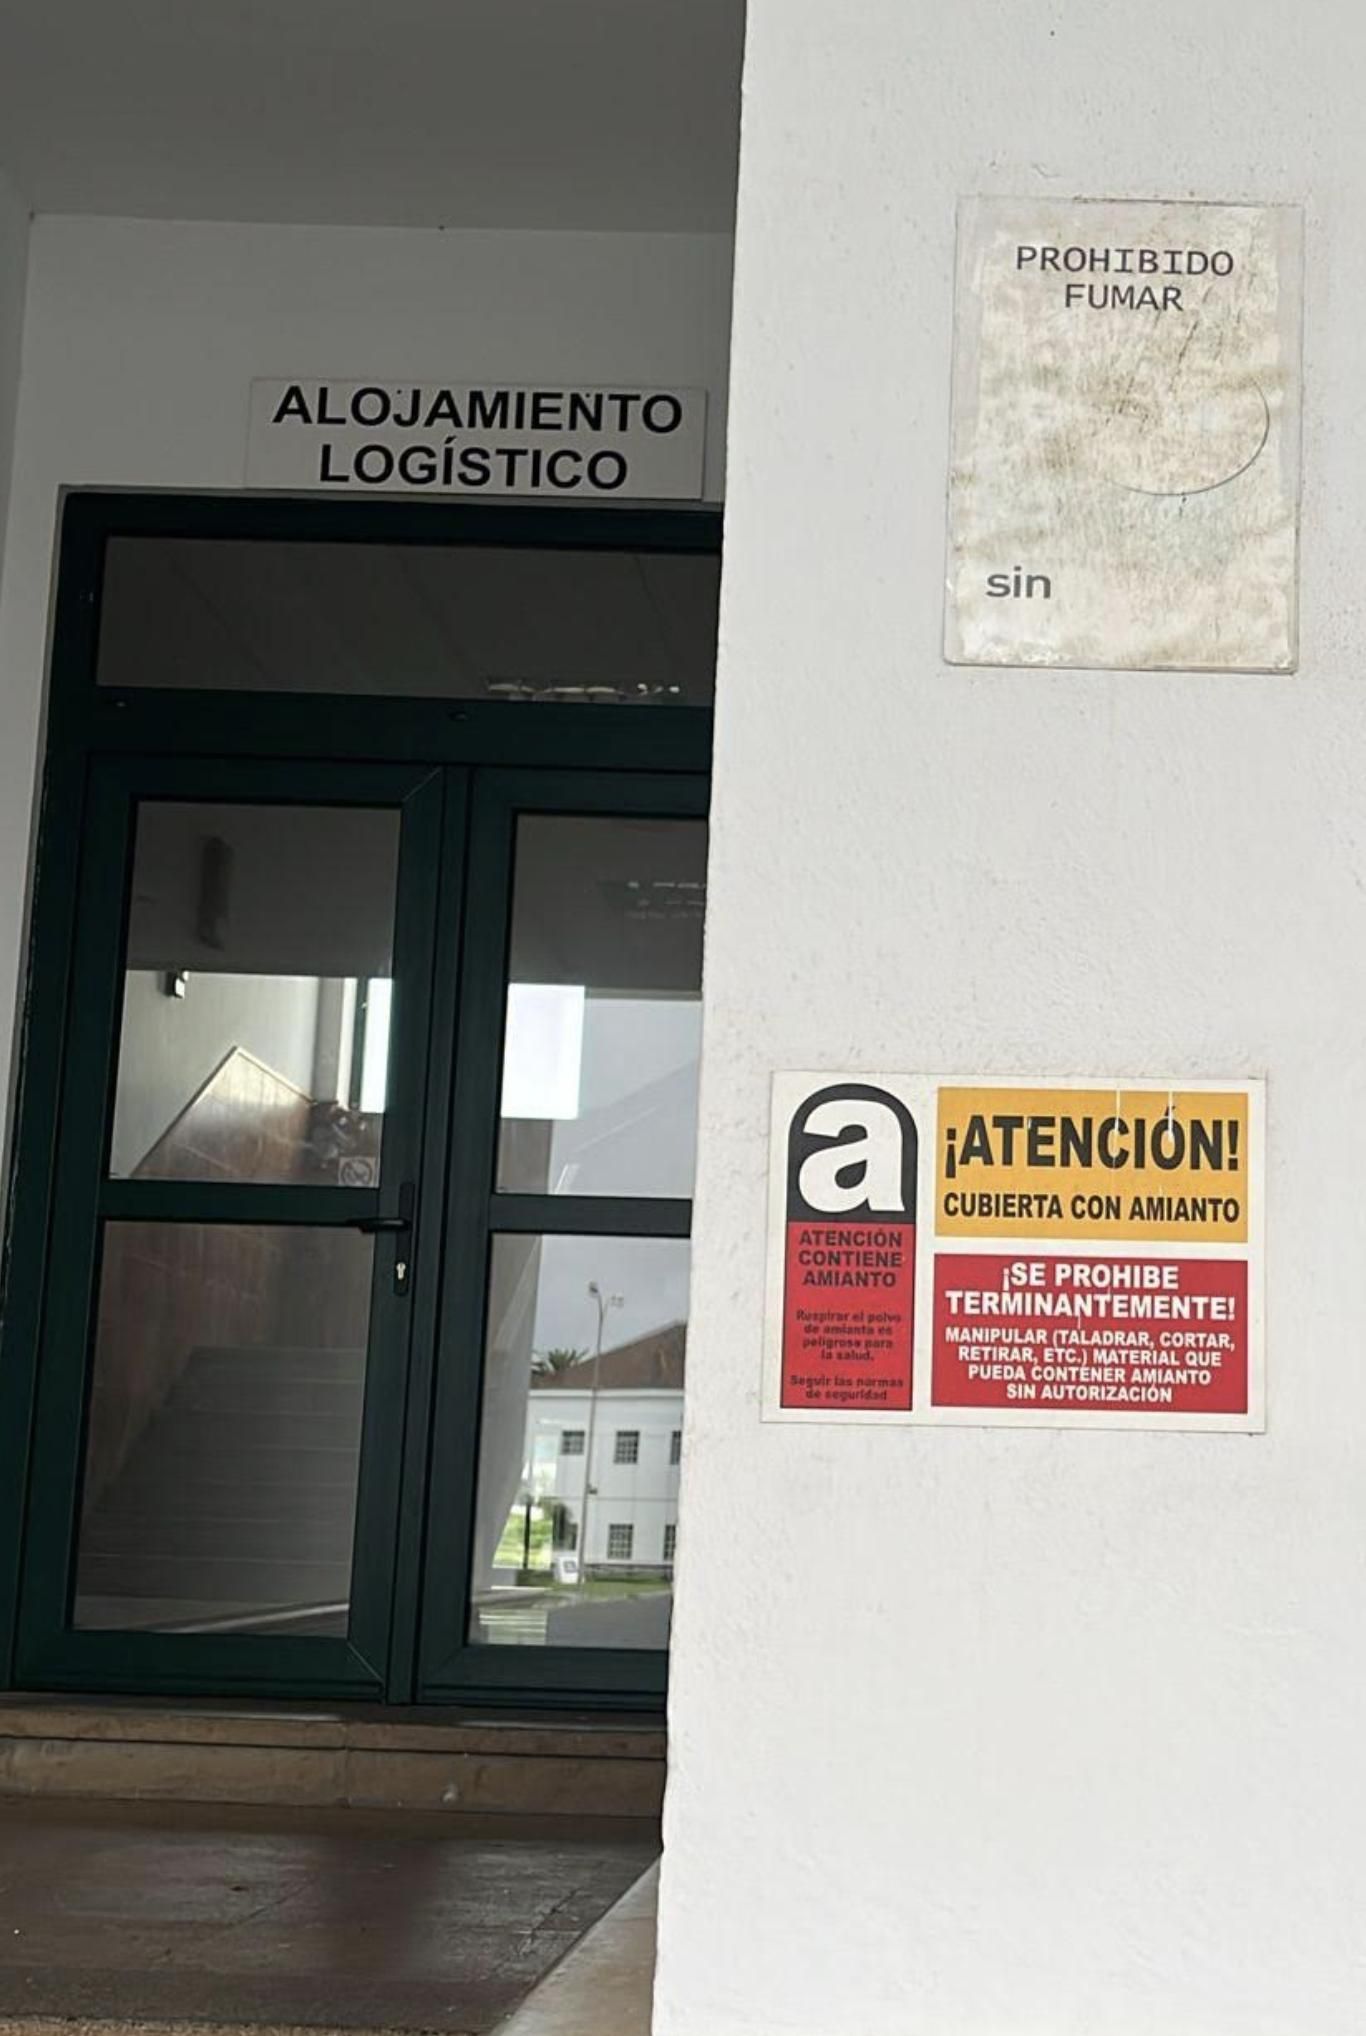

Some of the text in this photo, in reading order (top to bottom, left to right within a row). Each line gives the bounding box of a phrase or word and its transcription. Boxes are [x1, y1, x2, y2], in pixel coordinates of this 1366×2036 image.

[1015, 245, 1235, 277] PROHIBIDO
[1064, 283, 1184, 311] FUMAR
[271, 384, 683, 434] ALOJAMIENTO
[319, 435, 629, 490] LOGÍSTICO
[985, 565, 1052, 600] sin
[799, 1099, 905, 1213] a
[945, 1105, 1239, 1179] ¡ATENCIÓN!
[943, 1192, 1240, 1223] CUBIERTA CON AMIANTO
[799, 1227, 902, 1248] ATENCIÓN
[799, 1250, 903, 1268] CONTIENE
[802, 1269, 897, 1288] AMIANTO
[1002, 1262, 1179, 1291] ¡SE PROHIBE
[945, 1290, 1235, 1320] TERMINANTEMENTE!
[945, 1327, 1235, 1352] MANIPULAR (TALADRAR, CORTAR,
[958, 1345, 1222, 1367] RETIRAR, ETC.) MATERIAL QUE
[968, 1364, 1212, 1385] PUEDA CONTENER AMIANTO
[1006, 1382, 1173, 1403] SIN AUTORIZACIÓN
